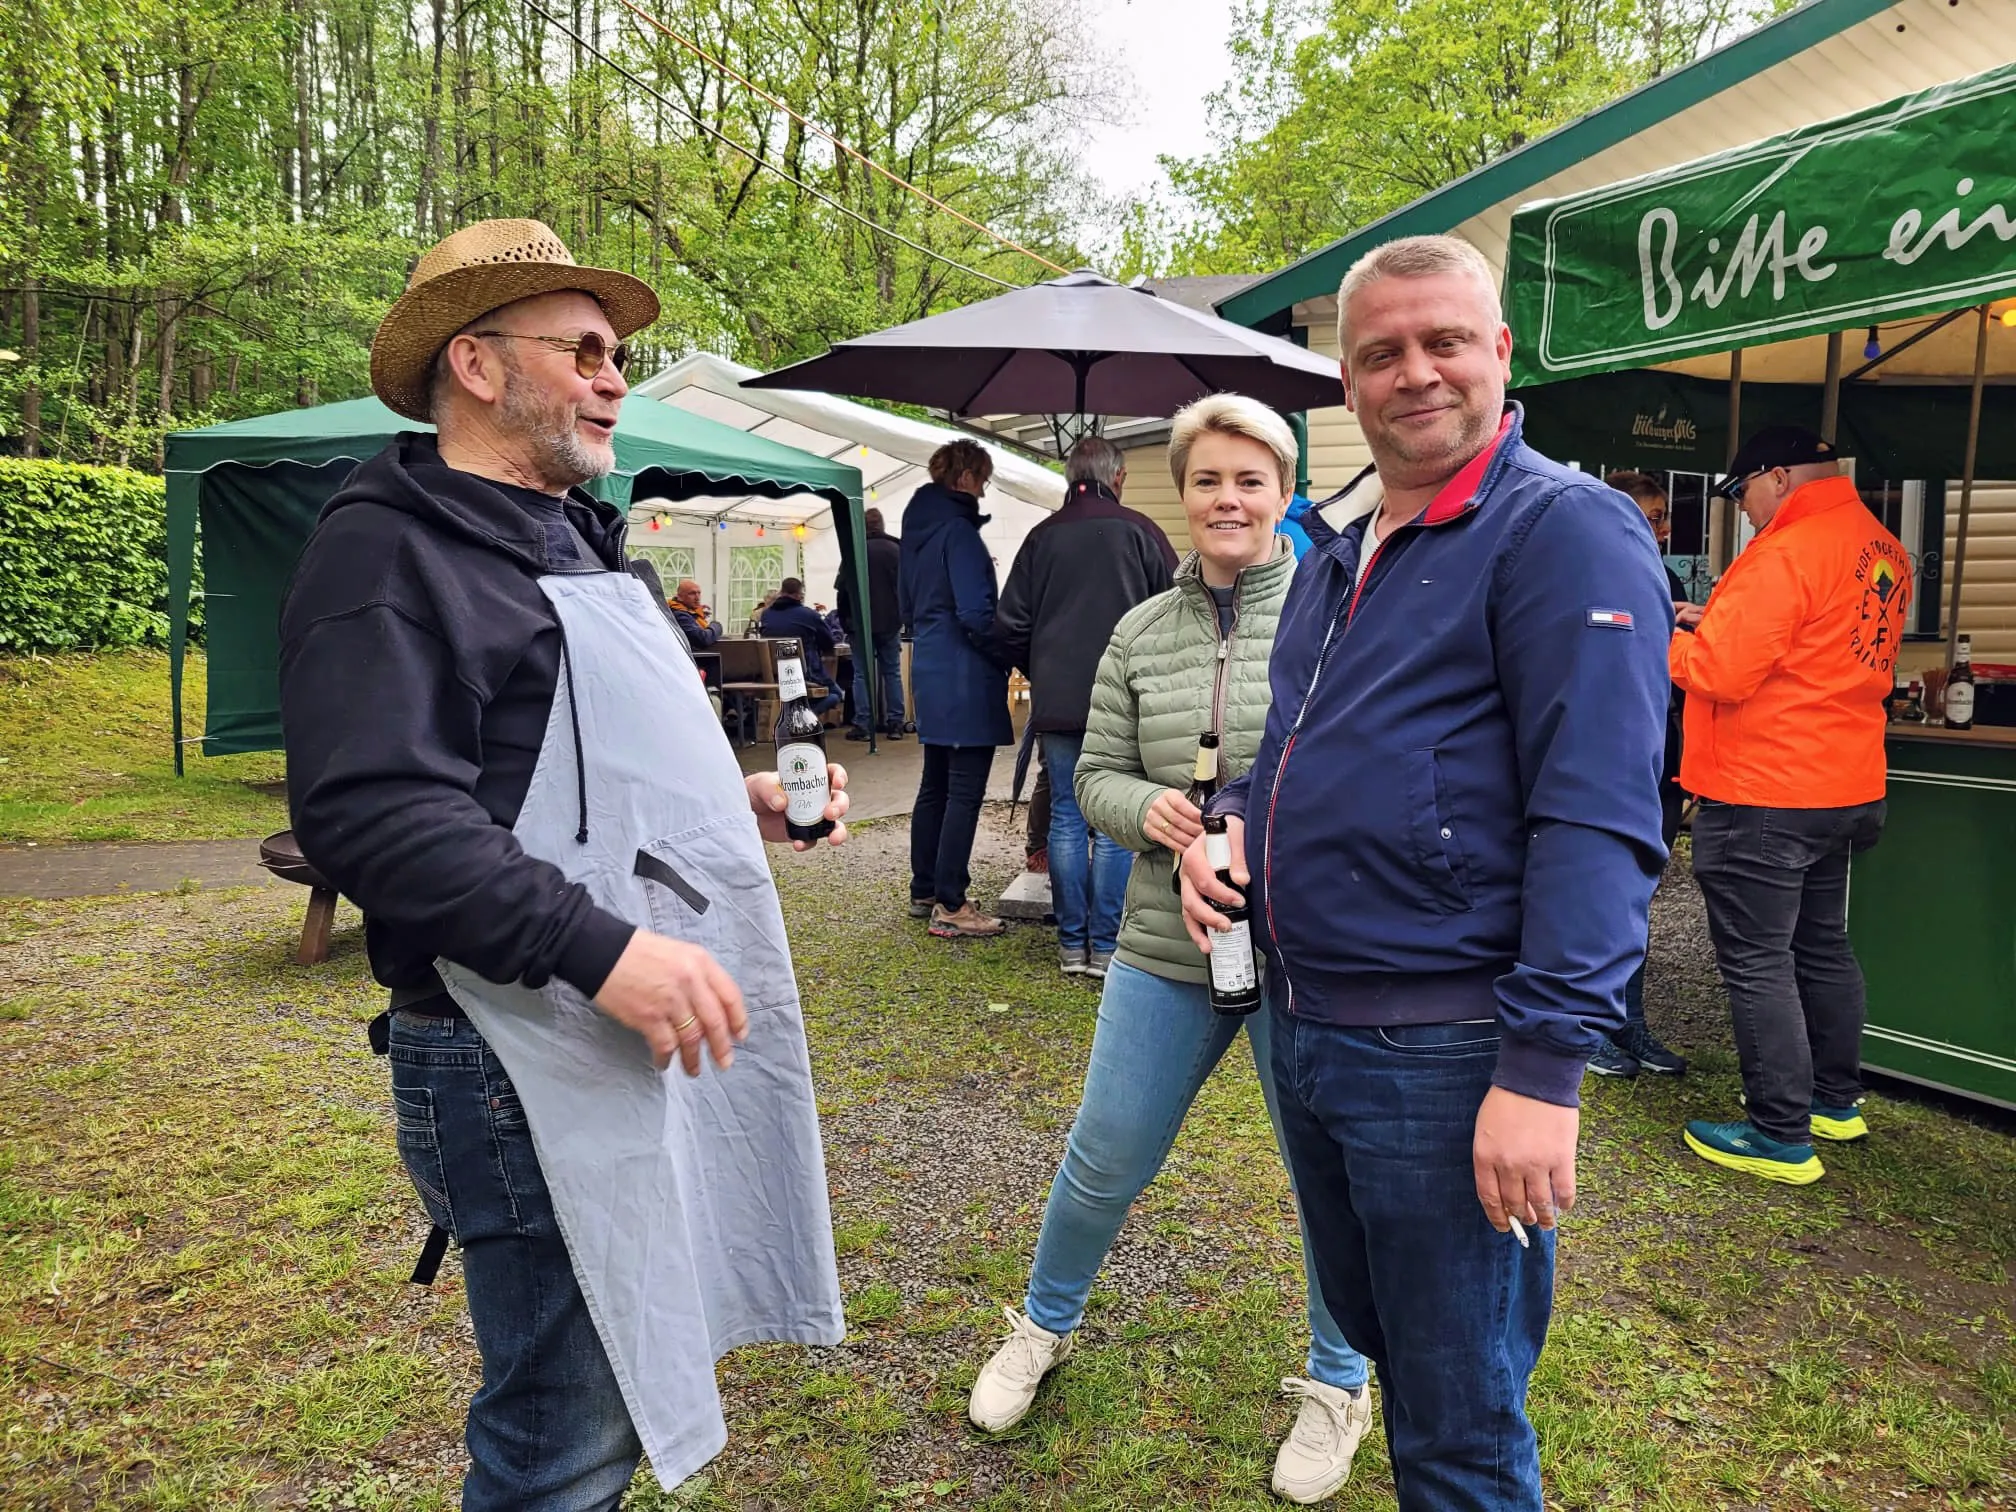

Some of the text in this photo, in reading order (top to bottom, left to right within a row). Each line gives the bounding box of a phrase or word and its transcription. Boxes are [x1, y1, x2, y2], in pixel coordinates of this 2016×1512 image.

[1638, 207, 1838, 331] Bitte
[1855, 540, 1911, 583] RIDE TOGETH
